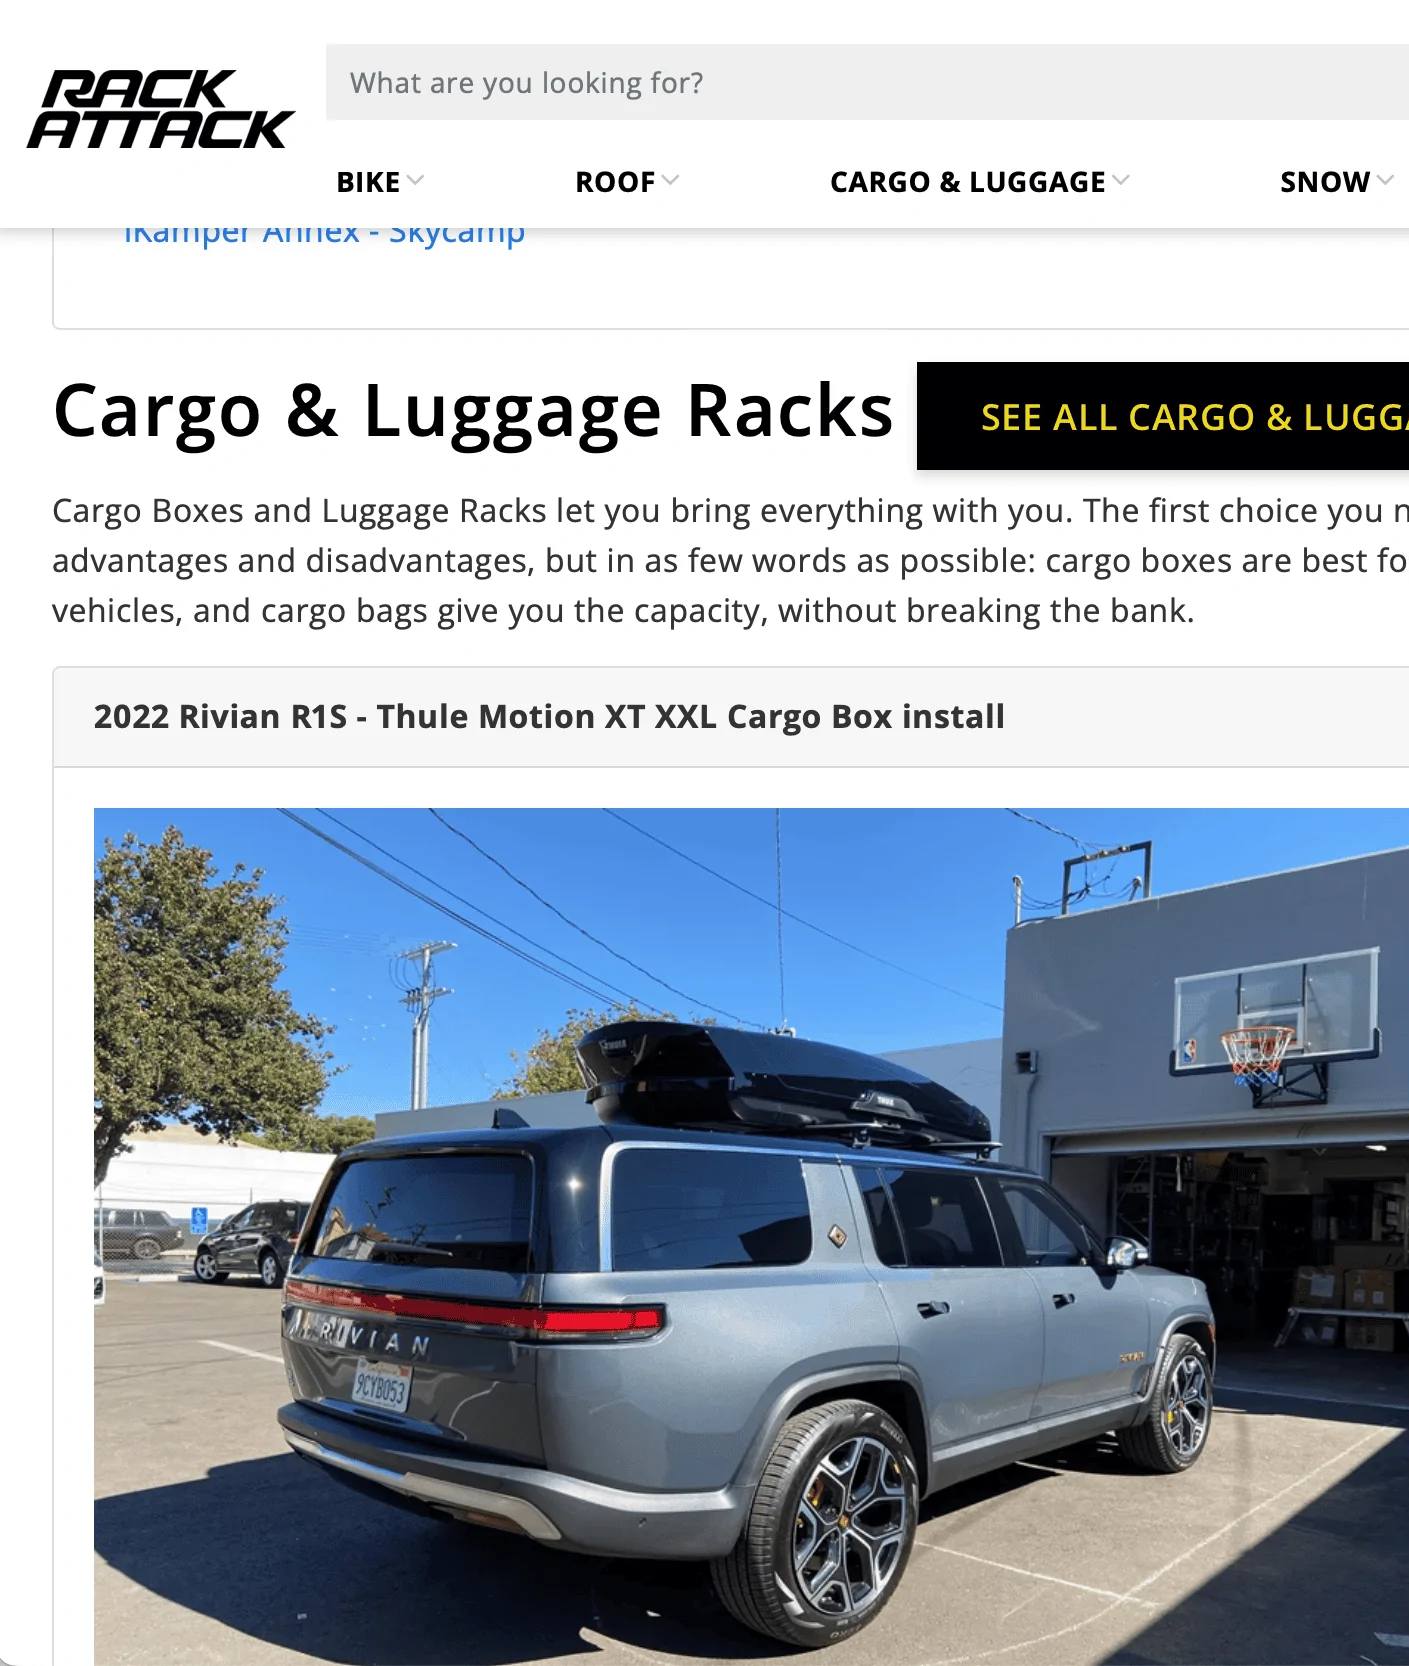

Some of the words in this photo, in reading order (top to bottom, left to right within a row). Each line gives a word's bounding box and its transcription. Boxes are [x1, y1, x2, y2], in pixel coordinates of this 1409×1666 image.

[40, 69, 237, 109] RACK
[349, 70, 421, 94] What
[430, 76, 474, 94] are
[482, 76, 531, 101] you
[543, 70, 642, 101] looking
[650, 70, 703, 94] for?
[25, 110, 297, 149] ATTACK
[337, 171, 400, 193] BIKE
[576, 170, 655, 193] ROOF
[830, 170, 930, 193] CARGO
[939, 170, 962, 193] &
[970, 170, 1105, 194] LUGGAGE
[1280, 170, 1371, 193] SNOW
[55, 382, 260, 454] Cargo
[287, 382, 339, 438] &
[367, 383, 661, 455] Luggage
[690, 380, 892, 438] Racks
[981, 403, 1041, 432] SEE
[1052, 403, 1118, 431] ALL
[1129, 403, 1254, 432] CARGO
[1267, 403, 1293, 432] &
[53, 497, 141, 531] Cargo
[153, 498, 244, 523] Boxes
[254, 496, 311, 523] and
[323, 498, 449, 531] Luggage
[461, 496, 547, 523] Racks
[557, 496, 596, 524] let
[603, 503, 659, 531] you
[672, 496, 751, 531] bring
[760, 496, 924, 531] everything
[932, 496, 997, 523] with
[1007, 503, 1072, 531] you.
[1082, 496, 1139, 523] The
[1148, 496, 1210, 523] first
[1219, 496, 1318, 523] choice
[1326, 503, 1382, 531] you
[52, 546, 228, 581] advantages
[238, 546, 295, 573] and
[306, 546, 534, 581] disadvantages,
[546, 546, 597, 573] but
[608, 547, 634, 573] in
[645, 553, 678, 573] as
[687, 546, 744, 573] few
[751, 546, 847, 573] words
[857, 553, 890, 573] as
[901, 546, 1035, 581] possible:
[1046, 553, 1131, 581] cargo
[1142, 546, 1232, 573] boxes
[1242, 553, 1292, 573] are
[1303, 546, 1368, 573] best
[51, 596, 182, 627] vehicles,
[193, 596, 250, 623] and
[261, 603, 346, 631] cargo
[357, 596, 428, 631] bags
[437, 597, 498, 631] give
[507, 603, 563, 631] you
[573, 596, 624, 624] the
[634, 597, 768, 631] capacity,
[777, 596, 897, 623] without
[907, 596, 1041, 631] breaking
[1049, 596, 1100, 623] the
[1111, 596, 1194, 624] bank.
[94, 703, 169, 729] 2022
[180, 702, 279, 729] Rivian
[292, 703, 347, 729] R1S
[376, 702, 468, 729] Thule
[480, 702, 594, 729] Motion
[604, 704, 646, 729] XT
[654, 704, 717, 729] XXL
[728, 703, 821, 737] Cargo
[833, 704, 893, 729] Box
[903, 702, 1004, 729] install
[319, 1321, 430, 1357] RIVIAN
[356, 1373, 405, 1405] 9CYB053
